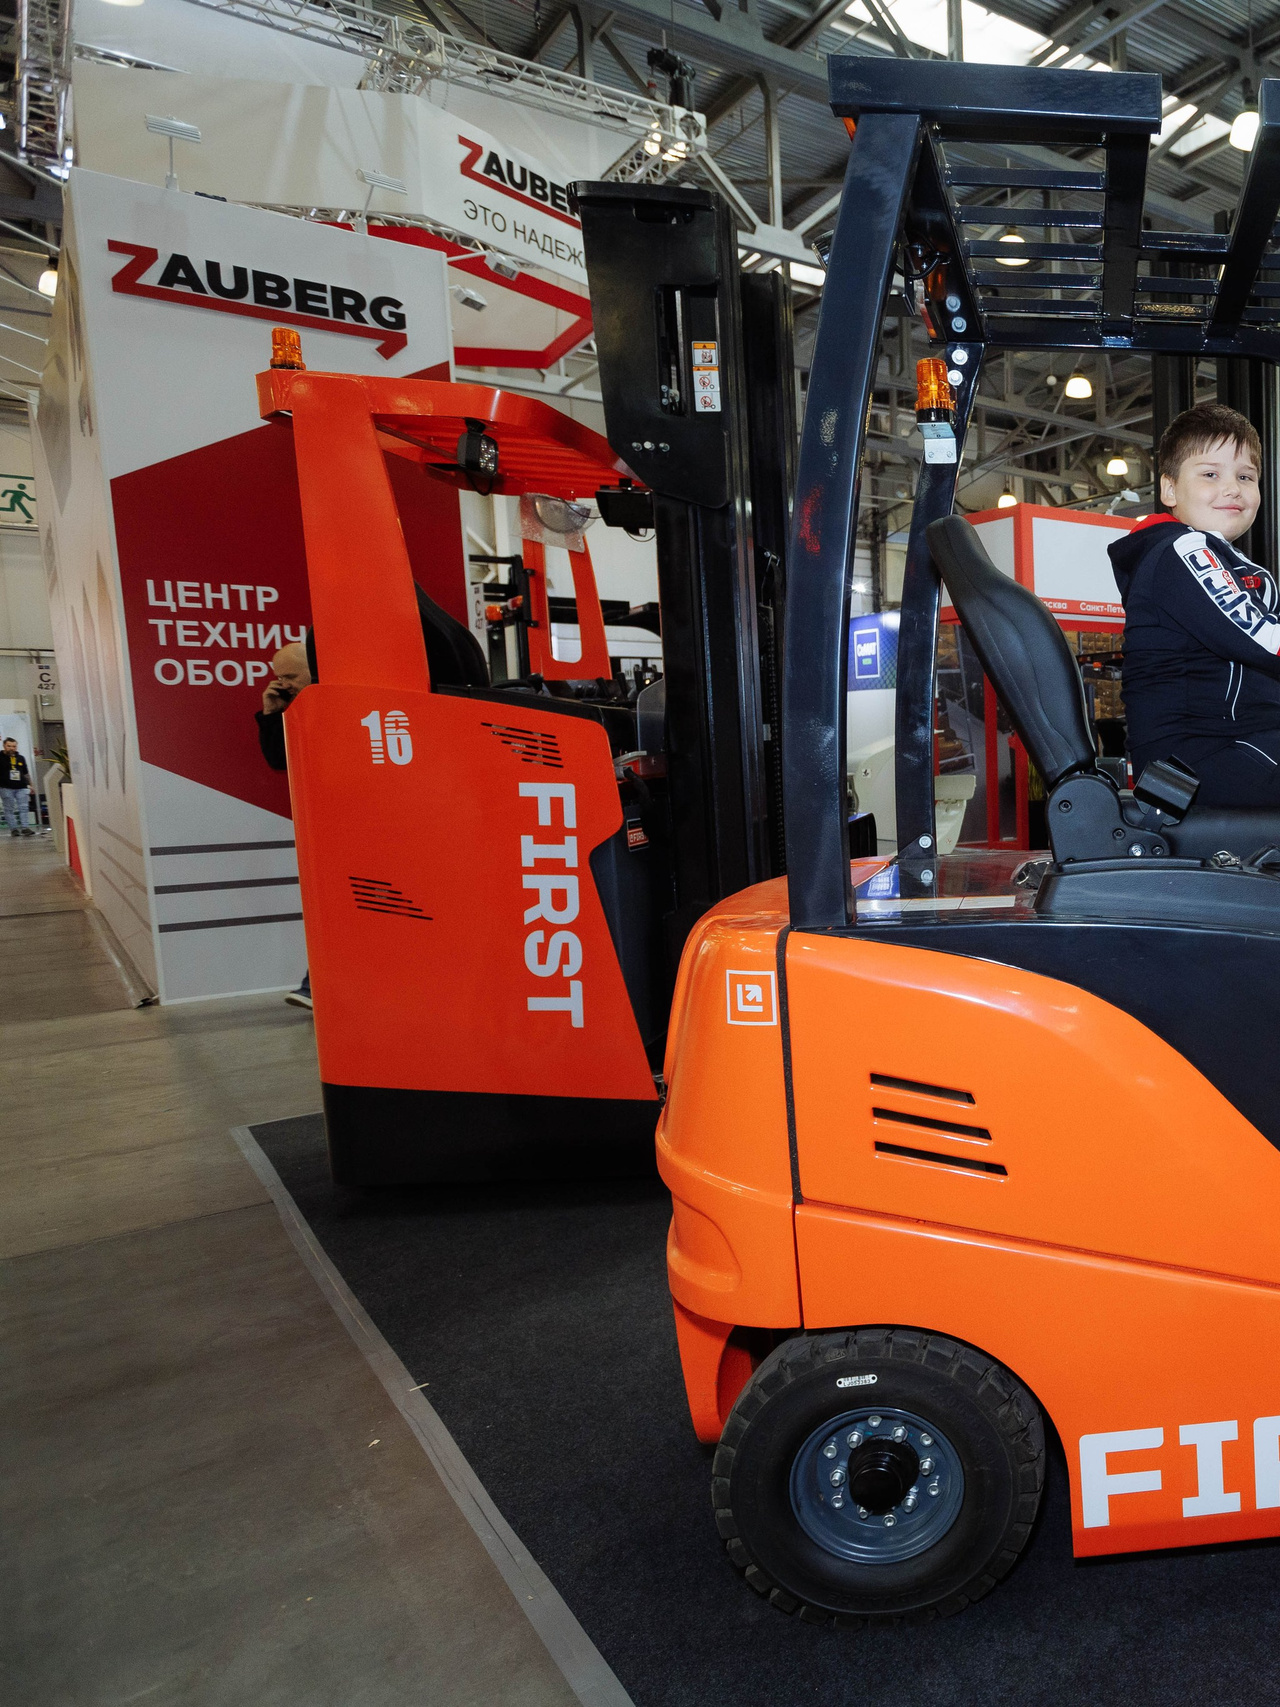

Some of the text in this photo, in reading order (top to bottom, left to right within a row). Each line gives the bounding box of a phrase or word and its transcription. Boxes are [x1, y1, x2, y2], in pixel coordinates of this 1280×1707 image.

[463, 199, 584, 268] ЭТО НАДЕЖ
[107, 238, 408, 345] ZAUBERG
[146, 579, 279, 613] ЦЕНТР
[148, 619, 307, 649] ТЕХНИЧ
[37, 683, 56, 691] 427
[154, 658, 275, 686] ОБОР
[361, 710, 413, 765] 16
[518, 782, 584, 1028] FIRST
